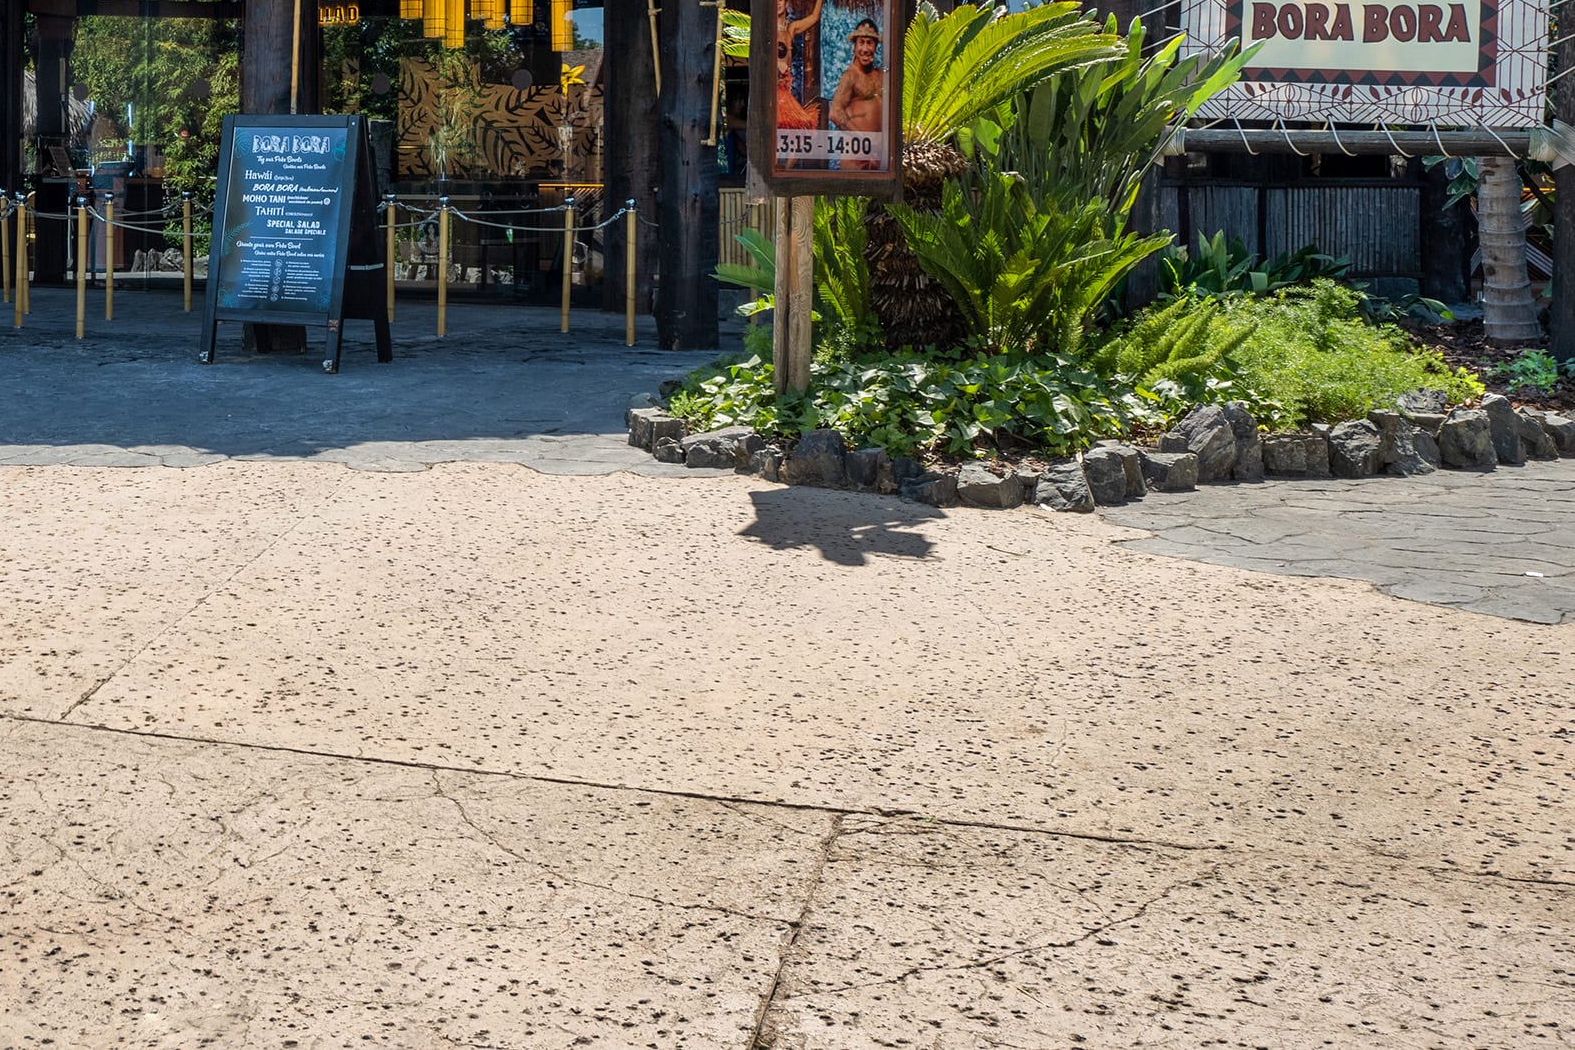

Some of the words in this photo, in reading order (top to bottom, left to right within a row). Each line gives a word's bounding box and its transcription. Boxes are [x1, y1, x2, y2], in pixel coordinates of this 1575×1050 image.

[1251, 2, 1355, 42] BORA
[1362, 3, 1471, 43] BORA
[252, 134, 290, 154] BORA
[292, 134, 331, 155] BORA
[777, 135, 812, 153] 3:15
[827, 136, 871, 155] 14:00
[245, 170, 273, 180] Hawái
[253, 183, 275, 192] BORA
[276, 183, 299, 193] BORA
[242, 194, 268, 203] MOHO
[269, 195, 286, 203] TANI
[255, 205, 285, 216] TAHITÍ
[266, 219, 295, 228] SPECIAL
[297, 220, 320, 229] SALAD
